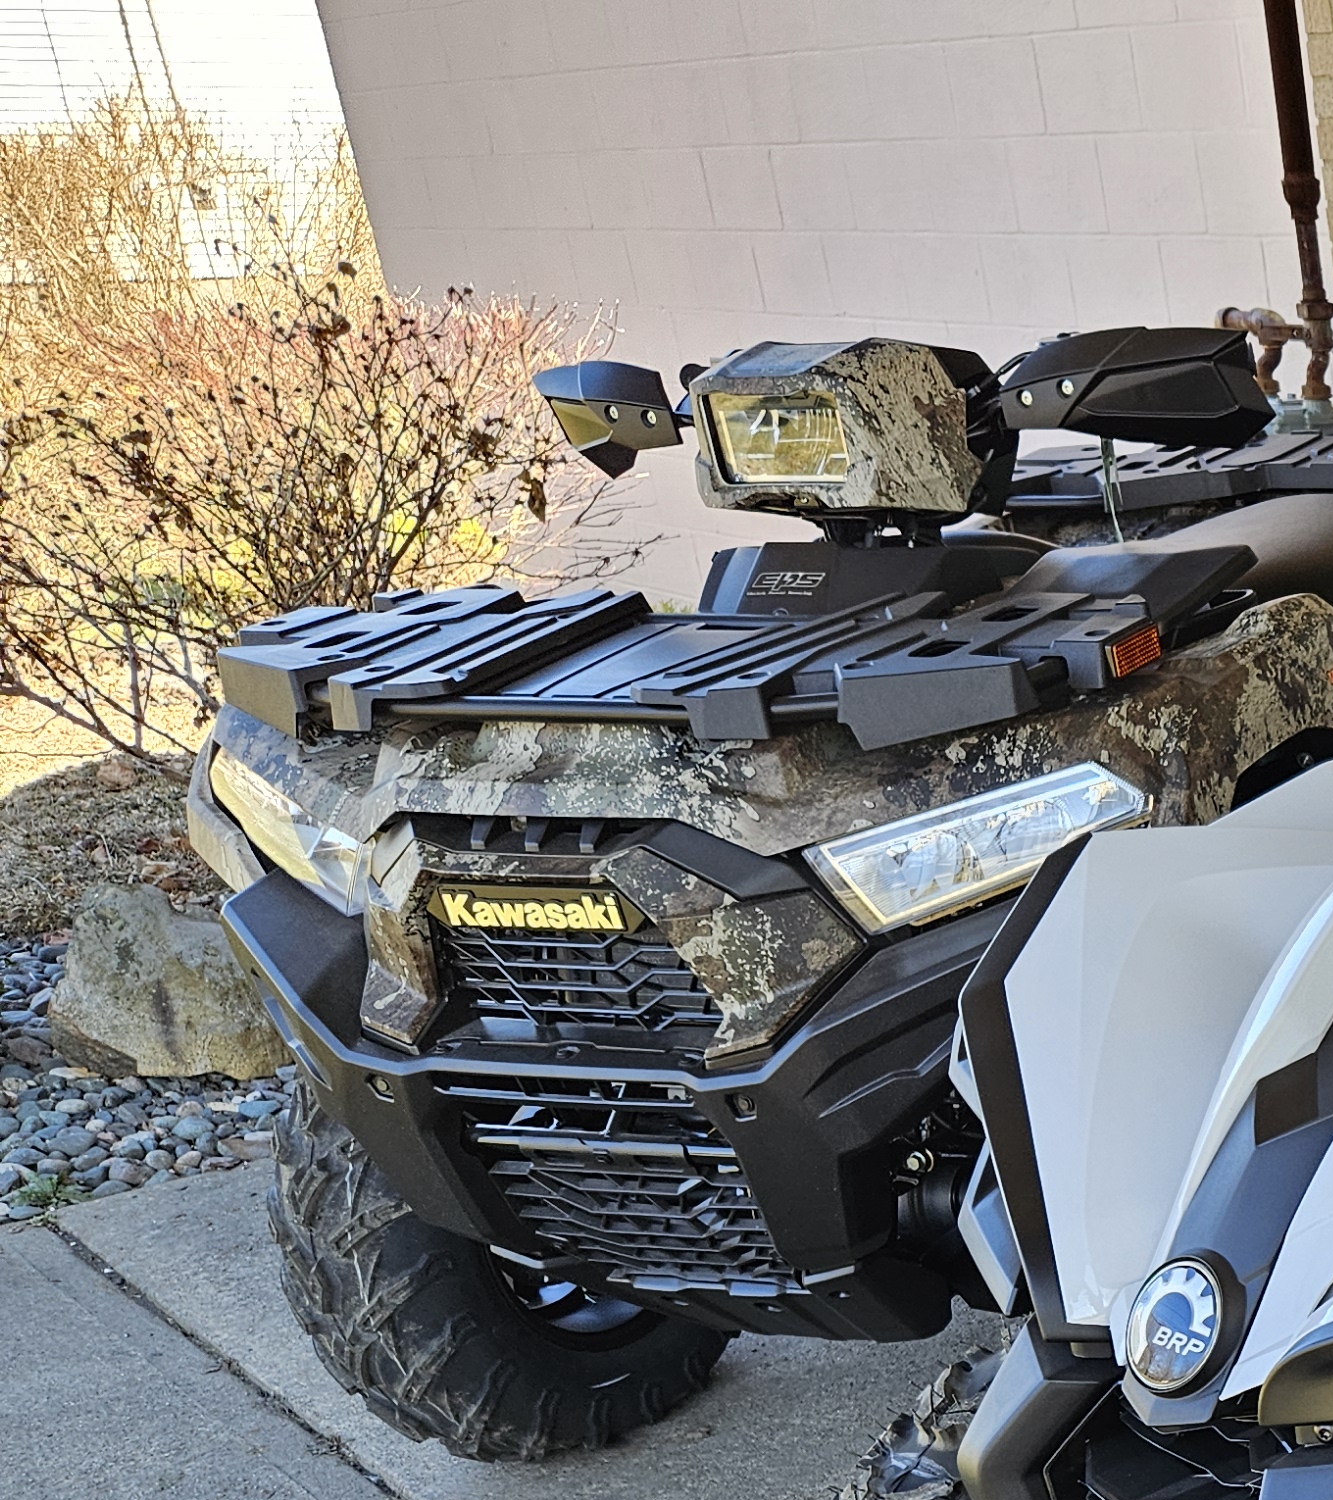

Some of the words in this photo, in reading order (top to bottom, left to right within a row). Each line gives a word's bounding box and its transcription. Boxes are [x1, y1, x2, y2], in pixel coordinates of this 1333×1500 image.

[752, 572, 826, 591] EPS
[440, 891, 625, 931] Kawasaki
[1152, 1325, 1206, 1356] BRP
